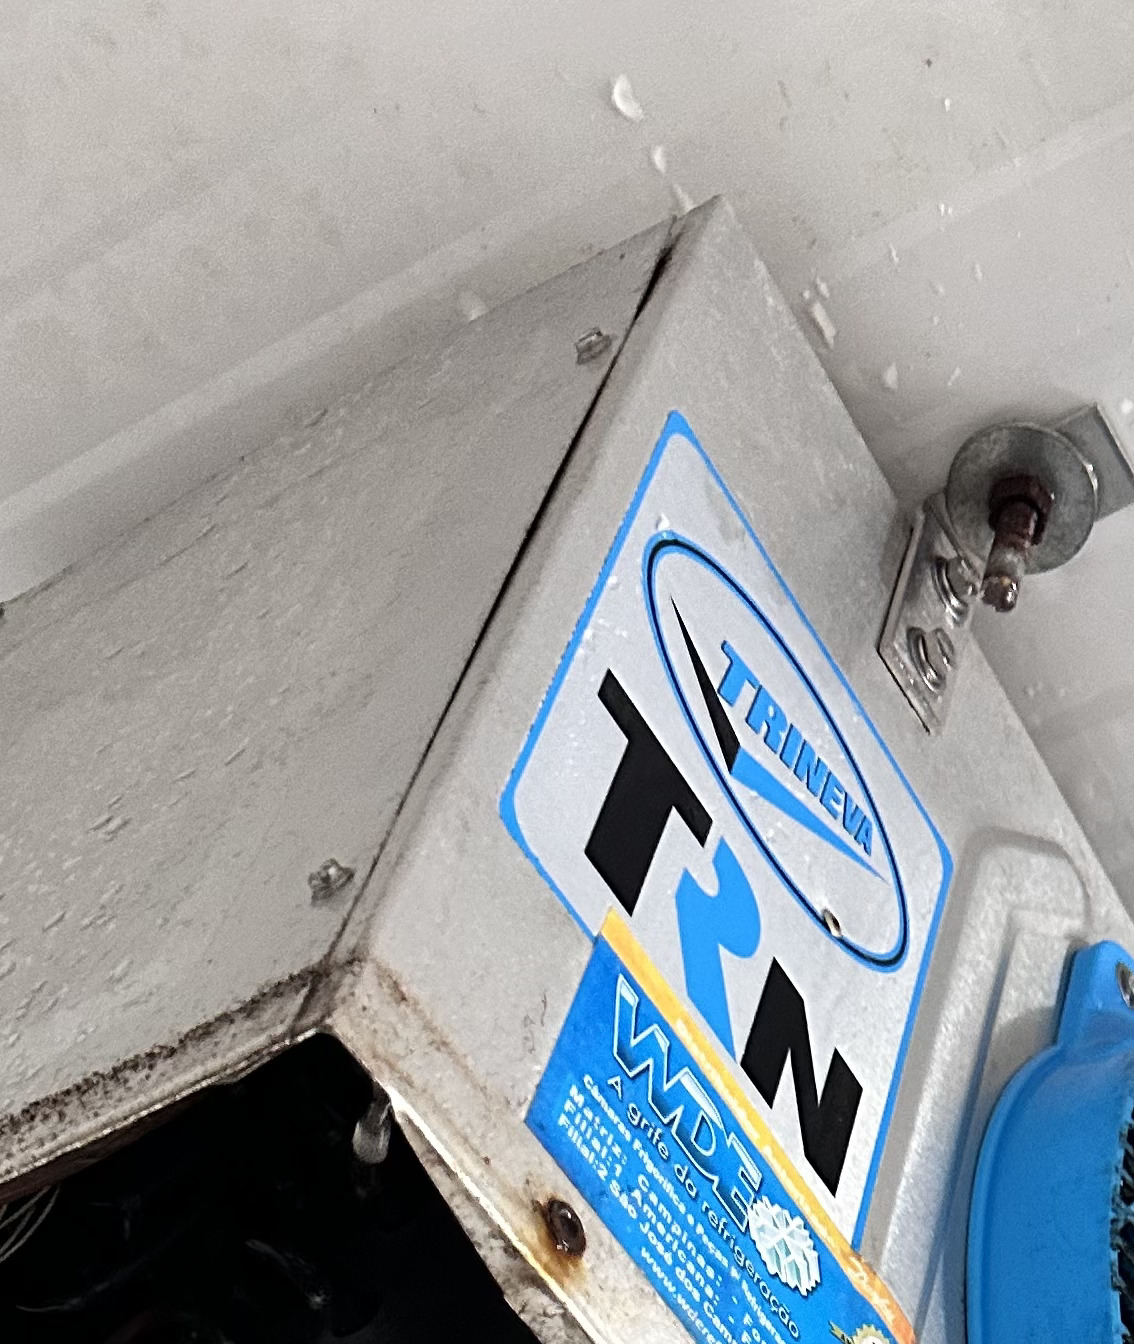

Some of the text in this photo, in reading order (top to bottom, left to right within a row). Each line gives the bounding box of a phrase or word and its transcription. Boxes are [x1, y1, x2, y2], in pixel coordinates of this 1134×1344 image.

[717, 640, 872, 856] TRINEVA
[569, 1084, 627, 1164] Matriz:
[637, 1173, 722, 1286] Campinas:
[607, 1075, 621, 1099] A
[627, 1102, 668, 1159] grife
[673, 1163, 697, 1197] da
[701, 1200, 798, 1337] refrigeração
[612, 973, 762, 1232] WDE
[609, 1179, 638, 1219] São
[639, 1221, 672, 1265] José
[675, 1266, 700, 1302] dos
[630, 1188, 719, 1305] Americana:
